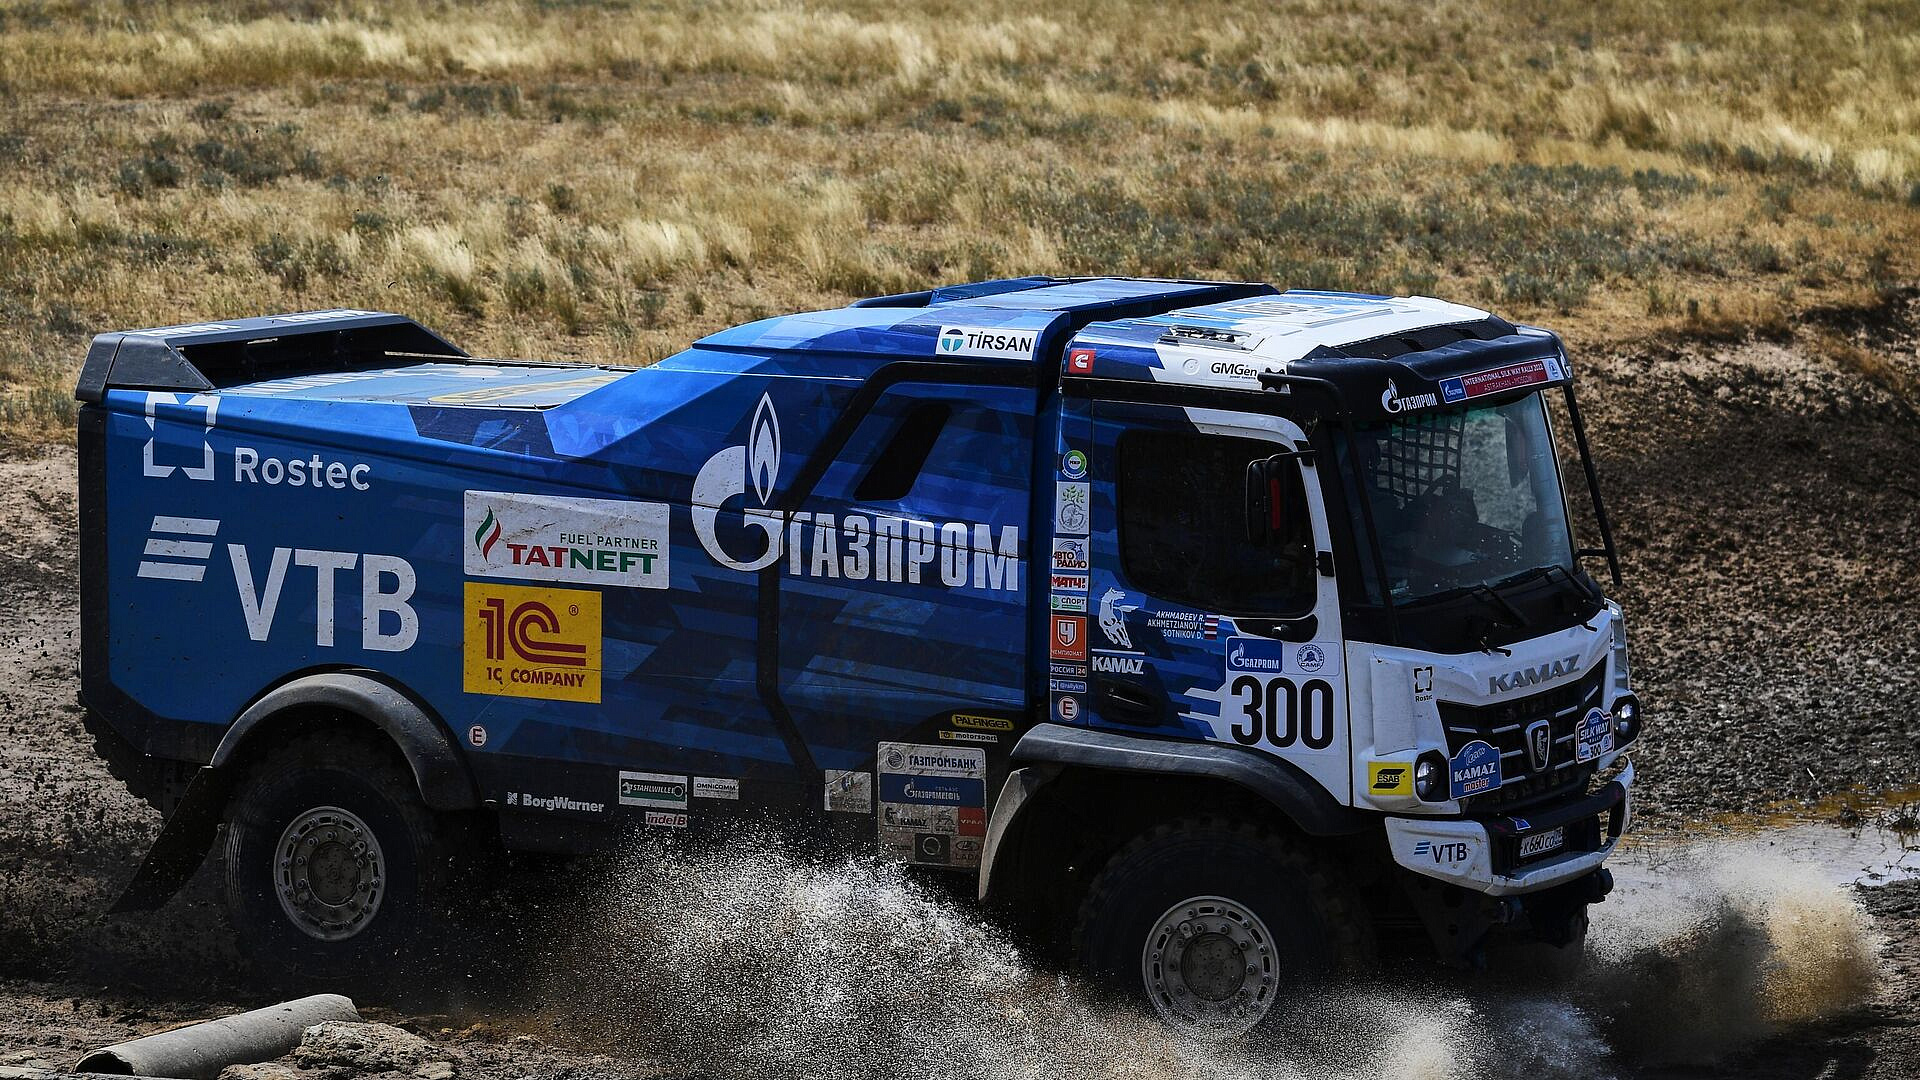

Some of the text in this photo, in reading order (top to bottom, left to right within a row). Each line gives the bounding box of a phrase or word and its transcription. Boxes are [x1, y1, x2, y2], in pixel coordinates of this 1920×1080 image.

[967, 331, 1032, 352] TİRSAN
[1211, 362, 1257, 377] GMGen
[1464, 372, 1501, 386] INTERNATIONAL
[1401, 393, 1438, 411] ГАЗПРОМ
[235, 447, 371, 490] Rostec
[560, 533, 658, 550] FUEL PARTNER
[507, 543, 658, 575] TATNEFT
[789, 511, 1019, 591] ГАЗПРОМ
[227, 543, 419, 652] VTB
[1147, 619, 1198, 630] AKHMETZIANOV
[1156, 611, 1197, 621] AKHMADEEV
[1163, 629, 1195, 639] SOTNIKOV
[1050, 665, 1075, 674] РОССИЯ
[1092, 656, 1144, 674] KAMAZ
[1245, 658, 1279, 669] GAZPROM
[510, 668, 586, 688] COMPANY
[1489, 654, 1580, 694] KAMAZ
[1231, 675, 1333, 749] 300
[955, 716, 1010, 729] PALFINGER
[955, 733, 998, 742] motorsport
[909, 755, 977, 769] ГАЗПРОМБАНК
[1377, 775, 1400, 783] ESAB
[1454, 762, 1496, 782] KAMAZ
[1463, 777, 1489, 792] master
[523, 793, 605, 812] BorgWarner
[1432, 843, 1467, 863] VTB
